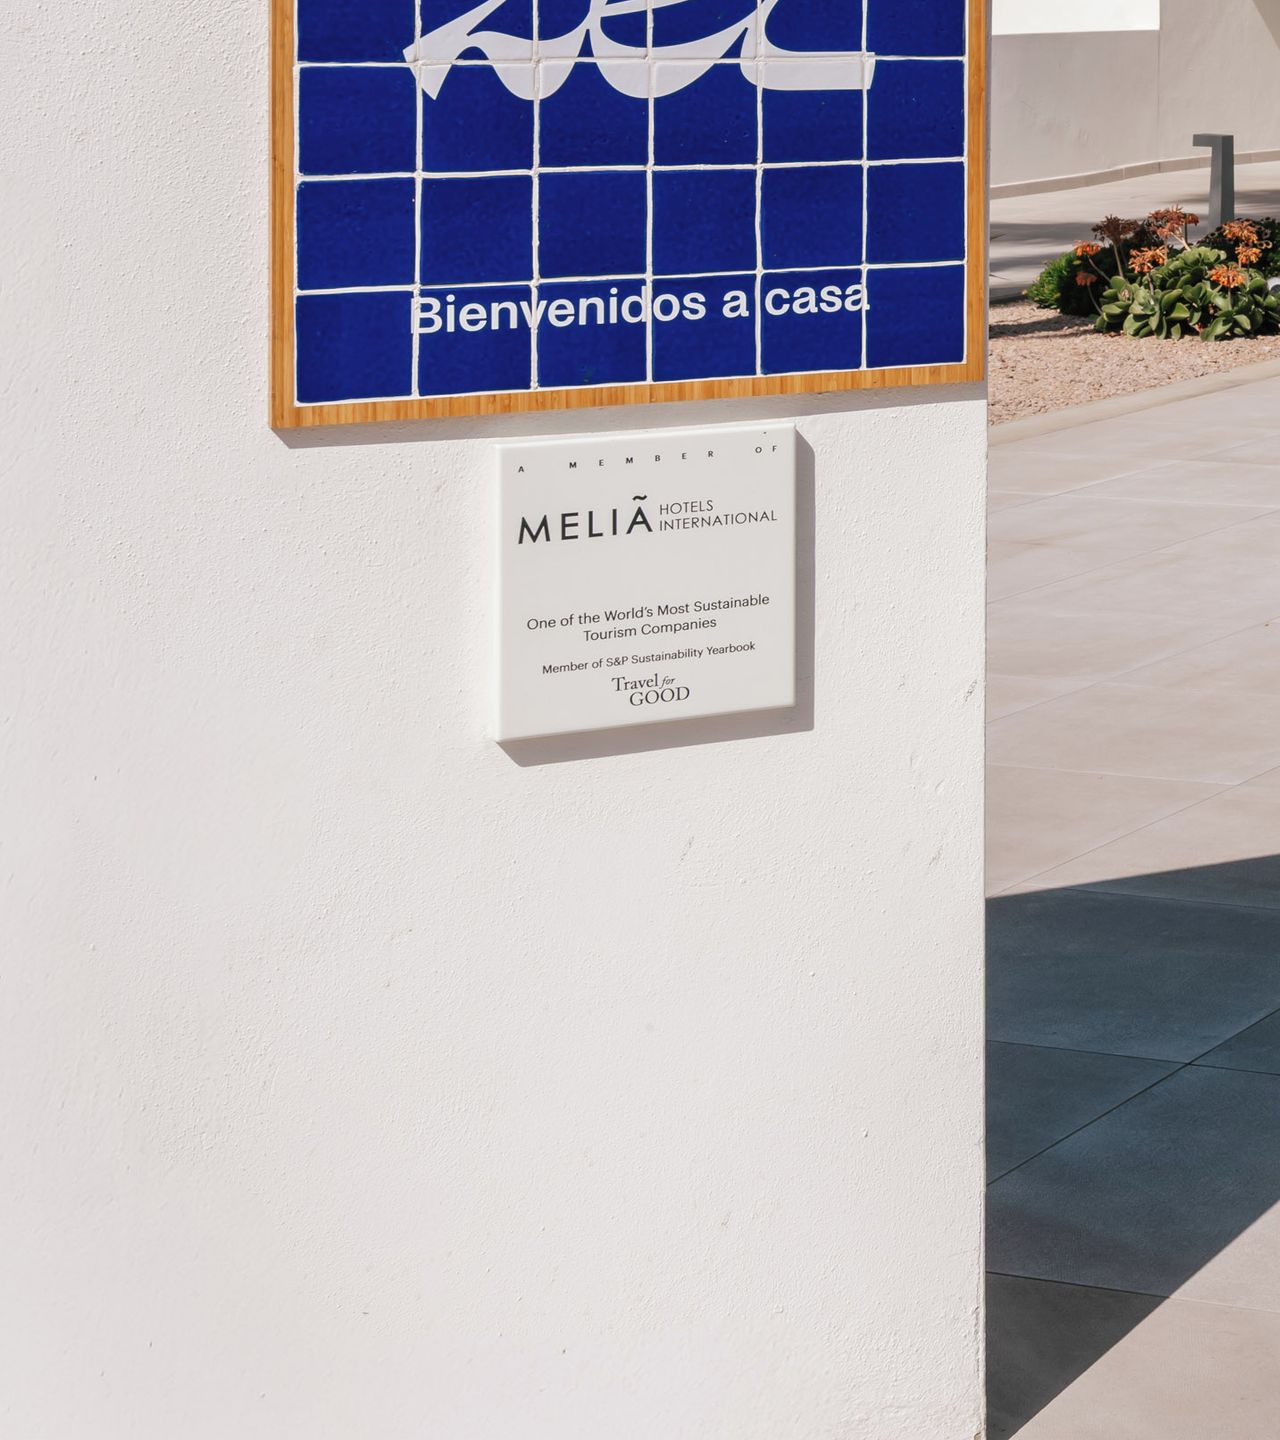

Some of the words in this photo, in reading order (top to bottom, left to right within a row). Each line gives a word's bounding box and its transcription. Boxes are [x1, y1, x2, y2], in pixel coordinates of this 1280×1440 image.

[409, 286, 708, 336] Bienvenidos
[721, 289, 750, 319] a
[764, 280, 871, 317] casa
[754, 445, 778, 454] OF
[659, 499, 714, 516] HOTELS
[659, 509, 778, 532] INTERNATIONAL
[526, 617, 557, 631] One
[560, 613, 575, 627] of
[577, 612, 601, 625] the
[604, 606, 654, 622] World's
[657, 603, 690, 617] Most
[693, 593, 770, 613] Sustainable
[583, 626, 637, 642] Tourism
[640, 617, 717, 636] Companies
[542, 659, 589, 675] Member
[591, 657, 604, 669] of
[606, 656, 629, 668] S&P
[631, 648, 704, 665] Sustainability
[706, 641, 756, 656] Yearbook
[611, 672, 659, 692] Travel
[658, 674, 676, 690] for
[629, 686, 690, 707] GOOD
